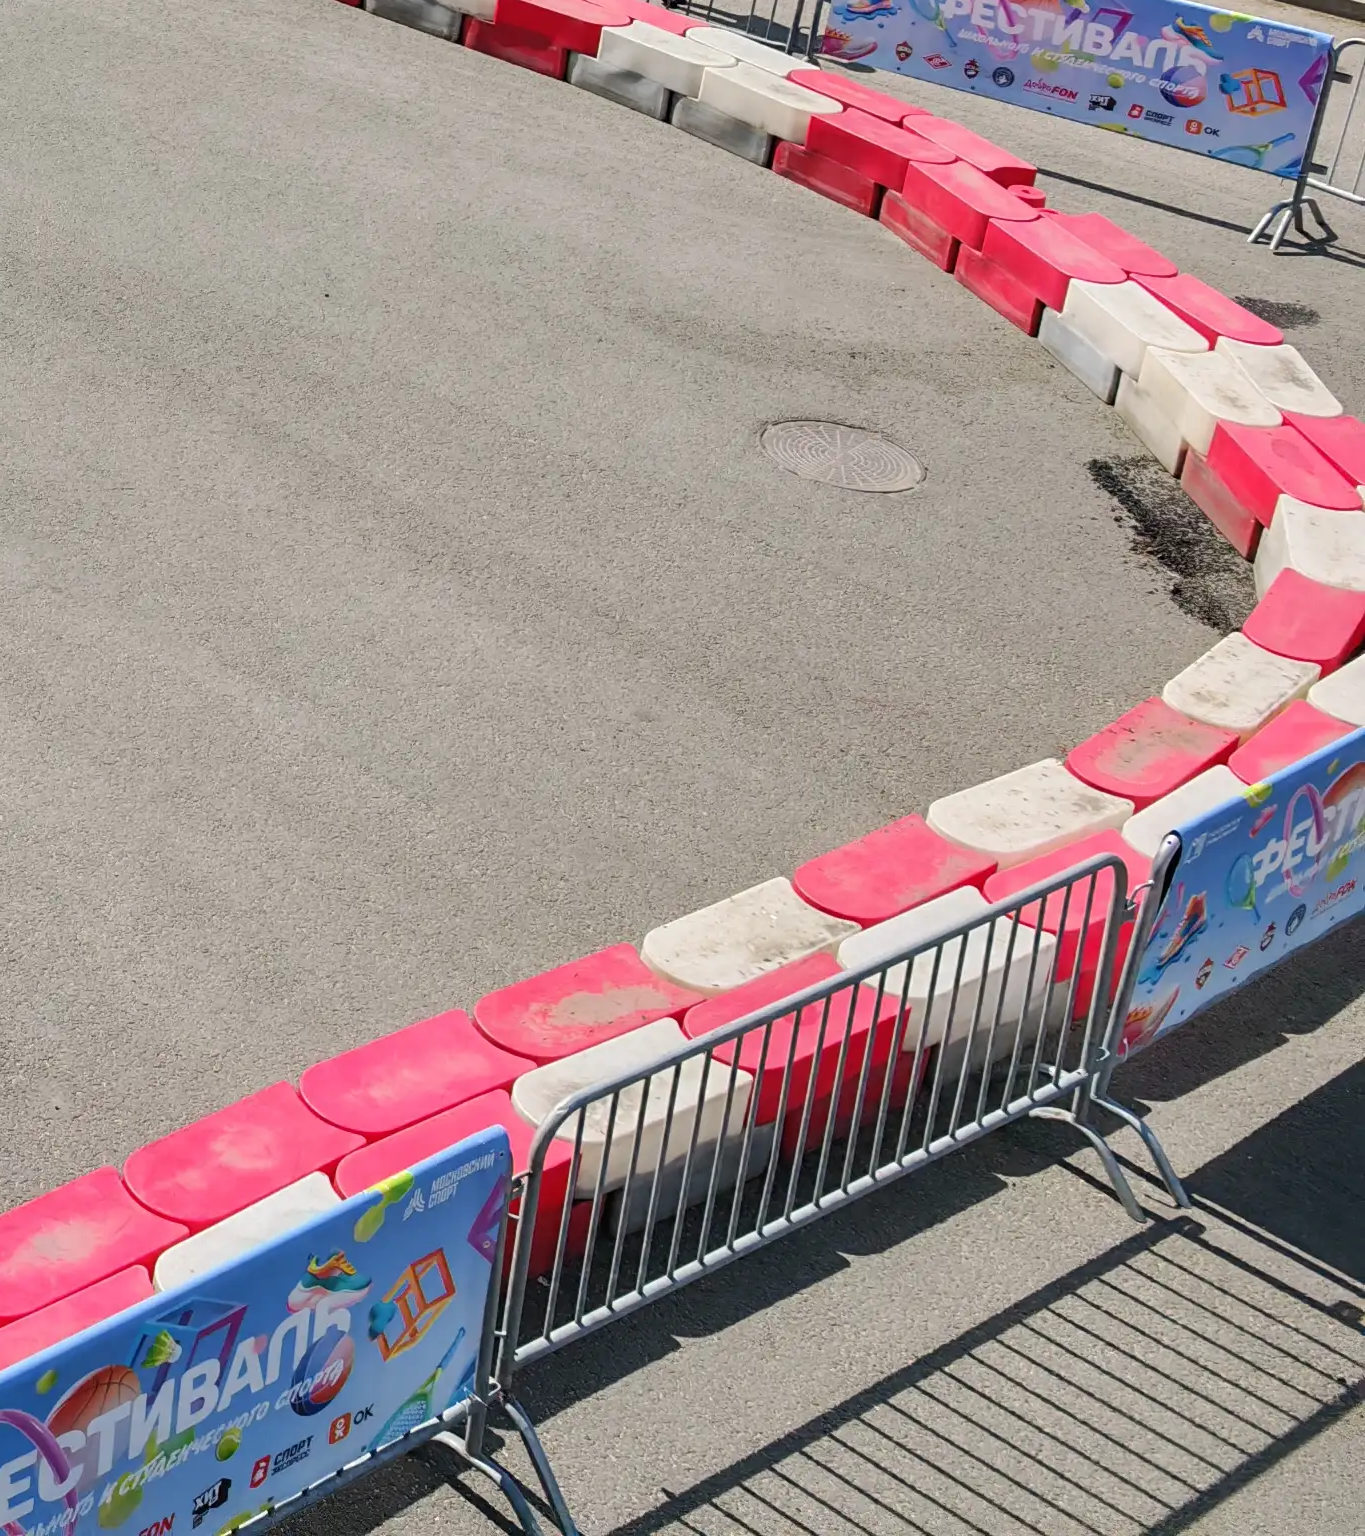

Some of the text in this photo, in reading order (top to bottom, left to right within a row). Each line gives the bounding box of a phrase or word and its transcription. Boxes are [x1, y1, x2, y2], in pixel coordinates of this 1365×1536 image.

[1146, 109, 1175, 122] СПОРТ
[430, 1151, 495, 1192] МОСКОВСКИЙ
[428, 1181, 458, 1210] СПОРТ
[273, 1435, 315, 1467] СПОРТ
